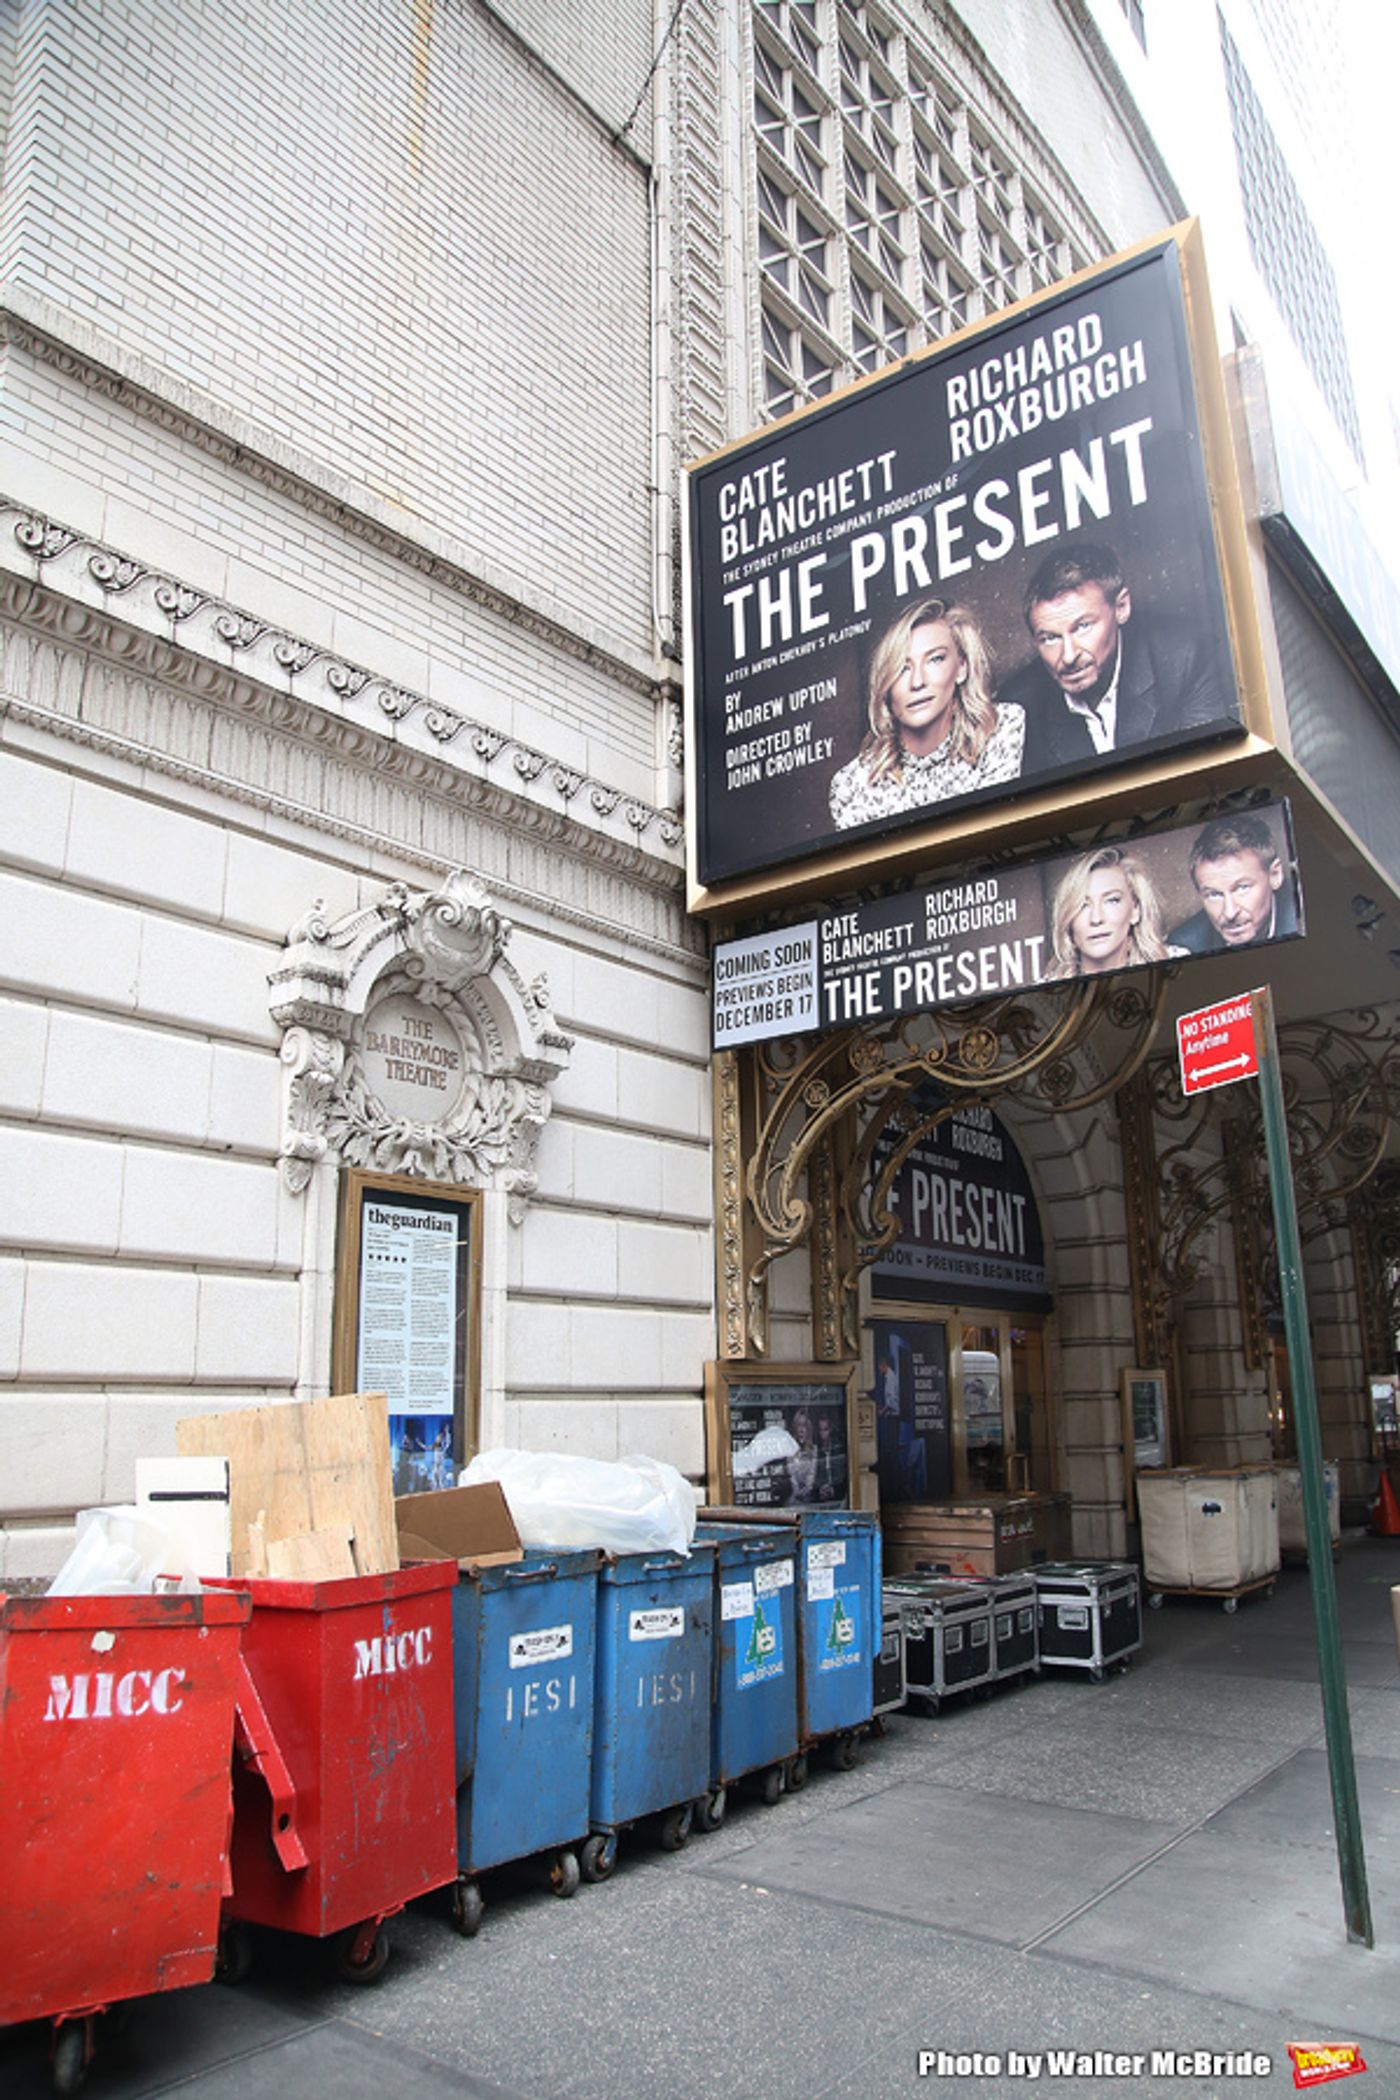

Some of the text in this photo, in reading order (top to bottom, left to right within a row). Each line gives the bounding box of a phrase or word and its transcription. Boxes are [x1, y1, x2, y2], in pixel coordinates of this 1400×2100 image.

[946, 313, 1103, 419] RICHARD
[949, 340, 1147, 463] ROXBURGH
[719, 457, 788, 522] CATE
[720, 450, 897, 564] BLANCHETT
[722, 473, 959, 584] THE SYDNEY THEATRE COMPANY PRODUCTION OF
[723, 416, 1153, 660] THE PRESENT
[725, 666, 749, 684] AFTER
[751, 655, 778, 676] ANTON
[828, 619, 872, 645] PLATONOV
[725, 691, 741, 713] BY
[725, 677, 838, 735] ANDREW UPTON
[725, 721, 813, 769] DIRECTED BY
[727, 737, 834, 790] JOHN CROWLEY
[925, 879, 998, 916] RICHARD
[821, 913, 859, 941] CATE
[926, 899, 1017, 941] ROXBURGH
[716, 939, 812, 981] COMING SOON
[823, 923, 914, 964] BLANCHETT
[716, 971, 813, 1007] PREVIEWS BEGIN
[824, 936, 1045, 1022] THE PRESENT
[402, 1016, 433, 1040] THE
[716, 994, 813, 1032] DECEMBER 17
[1182, 1021, 1199, 1038] NO
[366, 1031, 458, 1070] BARRYMORE
[1185, 1032, 1229, 1055] Anytime
[385, 1058, 447, 1091] THEATRE
[368, 1208, 453, 1233] theguardian
[911, 1168, 1026, 1256] PRESENT
[926, 1255, 980, 1276] PREVIEWS
[982, 1263, 1013, 1281] BEGIN
[353, 1626, 432, 1680] MICC
[43, 1668, 186, 1722] MICC
[506, 1675, 576, 1721] IESI
[637, 1670, 695, 1708] IESI
